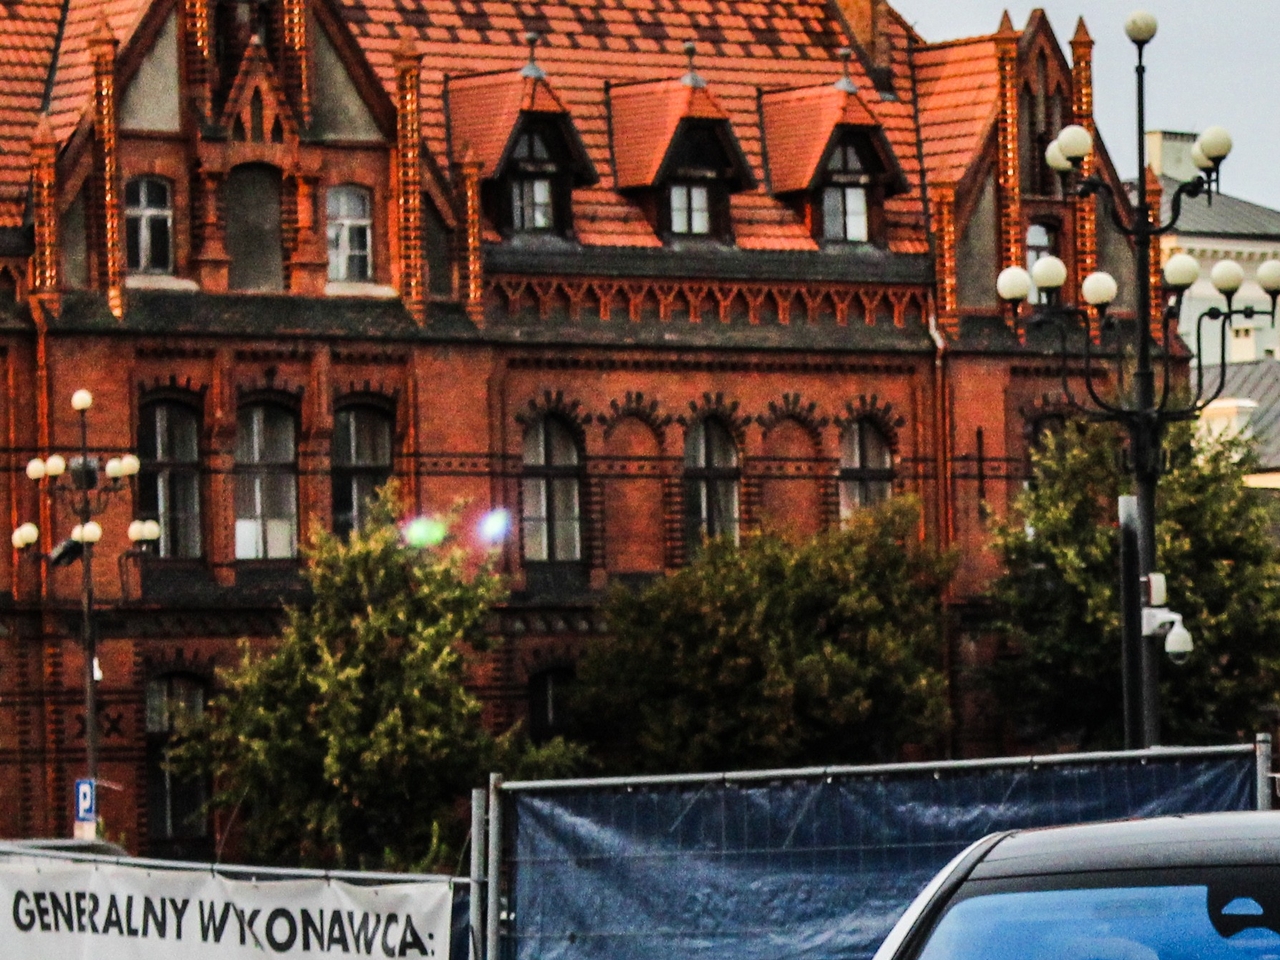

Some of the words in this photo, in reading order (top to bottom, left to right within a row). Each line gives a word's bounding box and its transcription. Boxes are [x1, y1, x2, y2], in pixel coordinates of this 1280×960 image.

[79, 783, 91, 818] P
[13, 890, 189, 940] GENERALNY
[199, 900, 435, 958] WYKONAWCA:
